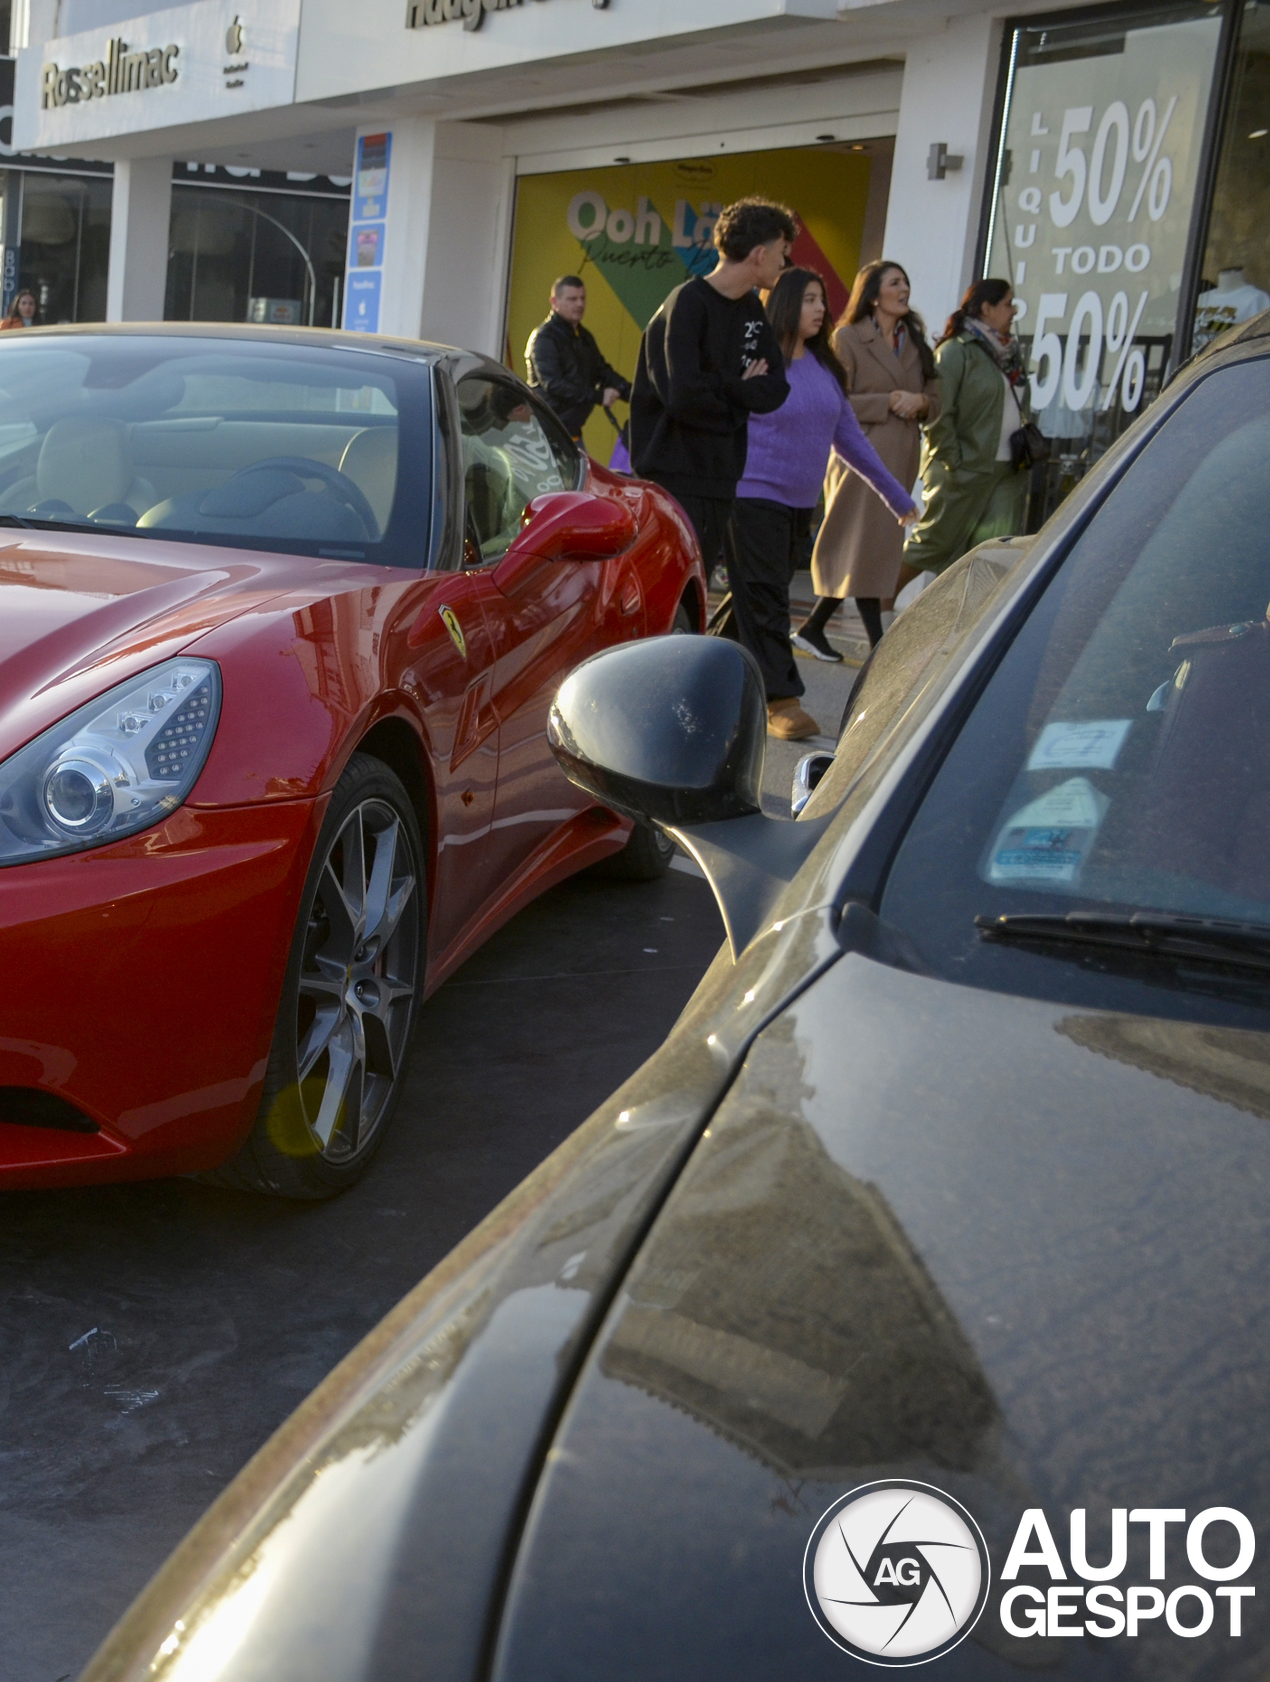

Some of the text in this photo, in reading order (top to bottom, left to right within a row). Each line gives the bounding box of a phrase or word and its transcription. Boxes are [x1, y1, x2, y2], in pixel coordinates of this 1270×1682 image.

[42, 37, 179, 110] Rossellimac
[1049, 96, 1177, 228] 50%
[567, 191, 661, 245] Ooh
[1052, 243, 1151, 275] TODO
[1029, 290, 1149, 413] 50%
